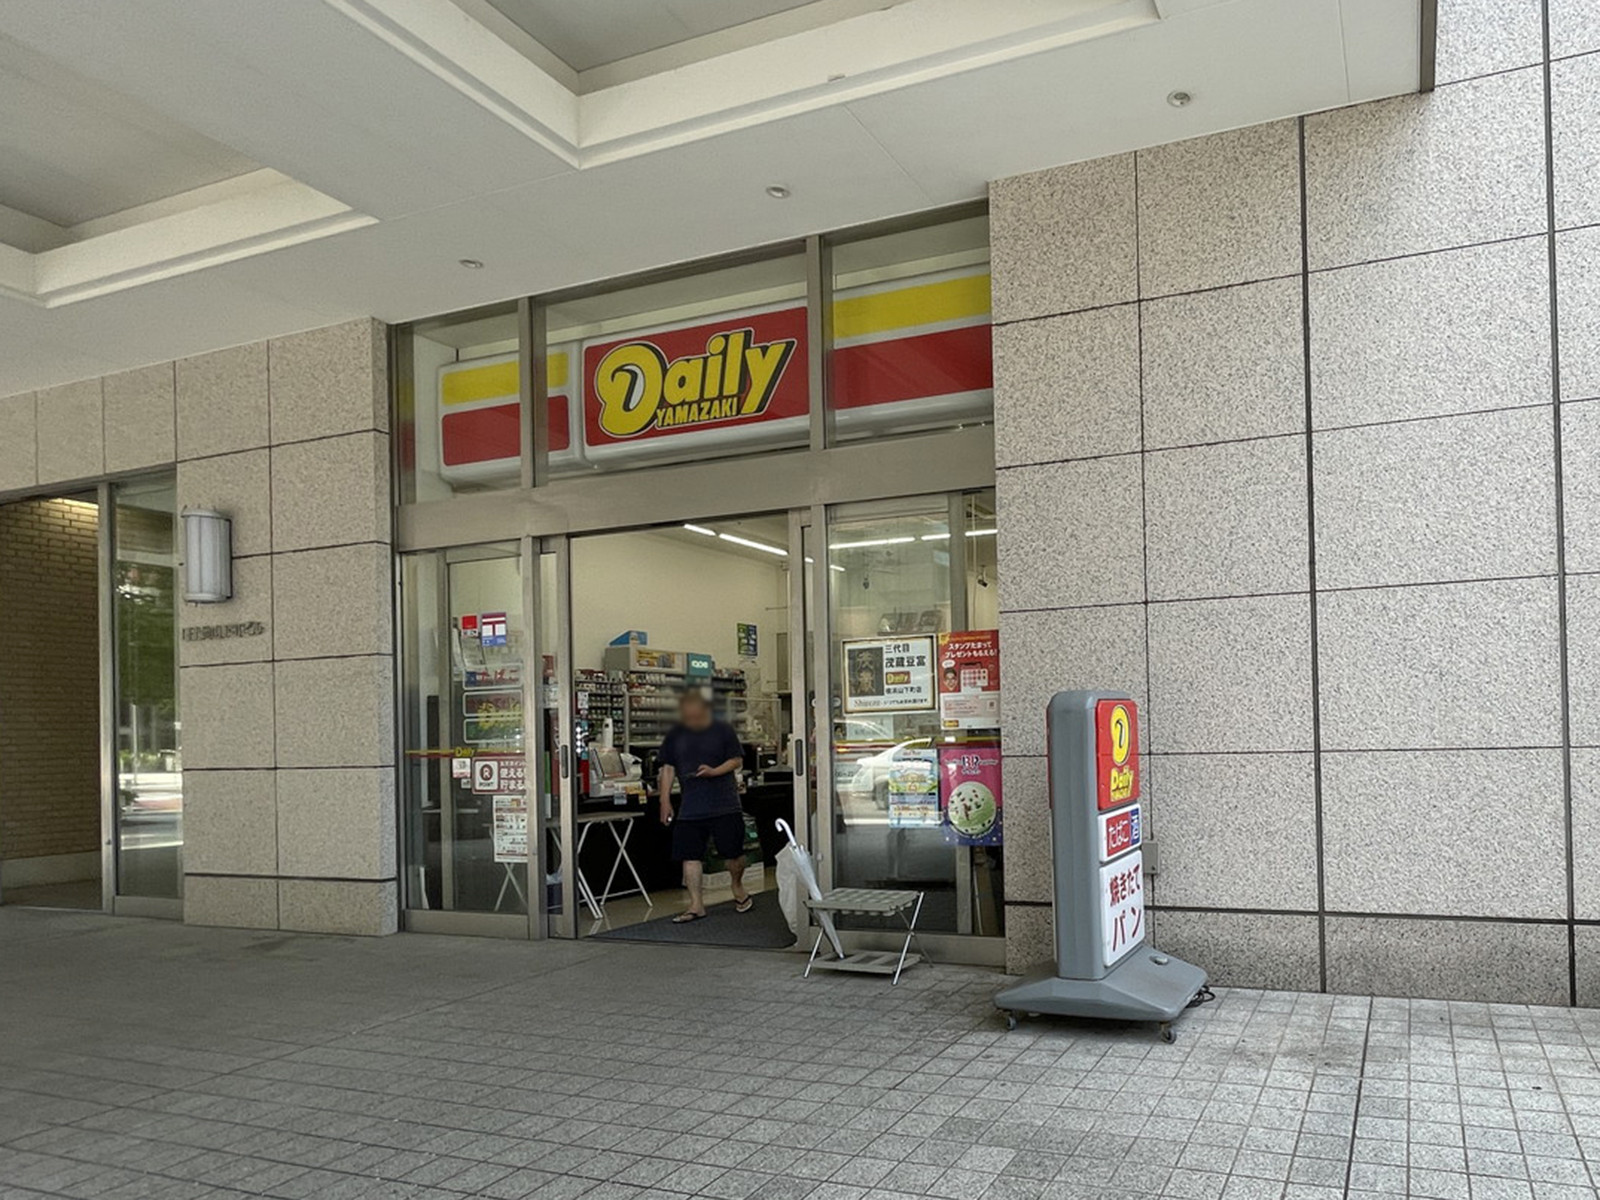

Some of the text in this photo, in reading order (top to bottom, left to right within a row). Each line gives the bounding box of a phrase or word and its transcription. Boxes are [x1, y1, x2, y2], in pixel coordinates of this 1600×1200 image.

[597, 329, 795, 437] Daily
[656, 397, 739, 428] YAMAZAKI
[885, 643, 910, 654] 三代目
[948, 641, 993, 651] スタンプたまって
[1108, 820, 1129, 850] たばこ
[1109, 864, 1140, 907] 焼きたて
[1112, 907, 1142, 952] パン
